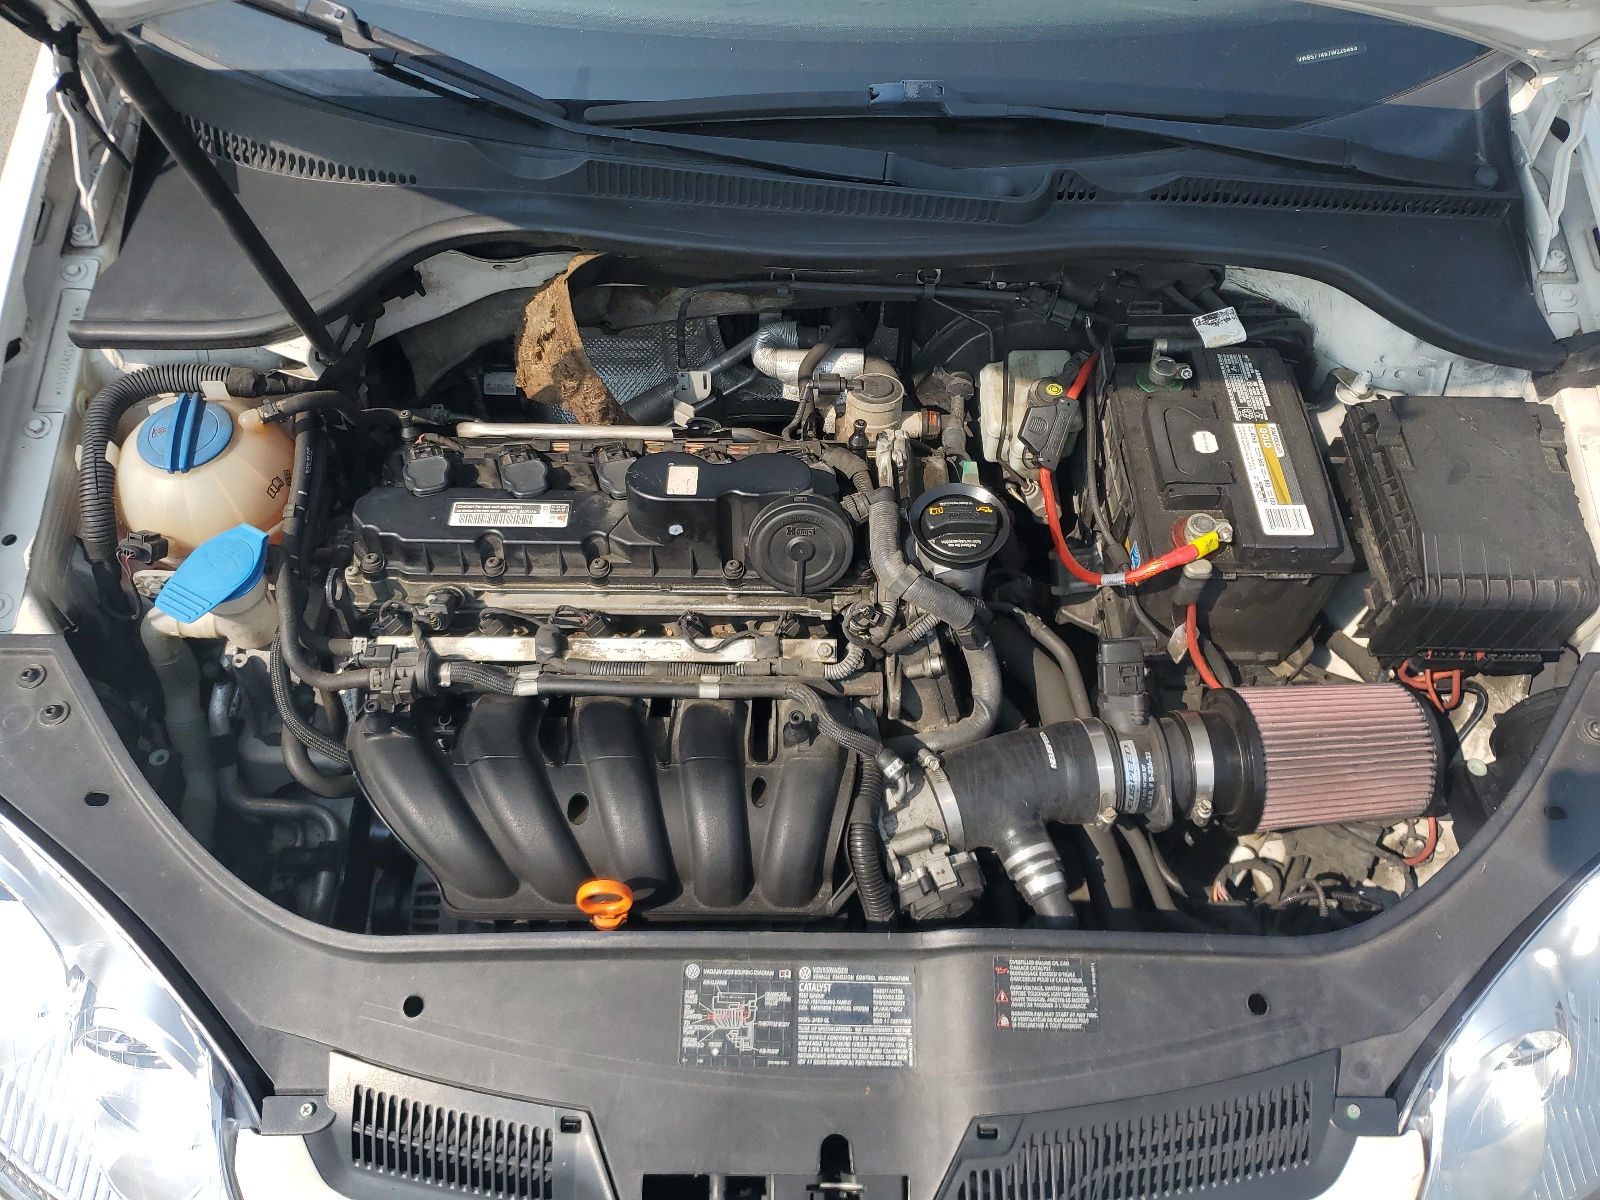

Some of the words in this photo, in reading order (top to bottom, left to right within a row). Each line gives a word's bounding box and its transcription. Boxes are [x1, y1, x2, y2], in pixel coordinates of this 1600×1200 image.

[1259, 427, 1272, 448] GOLD
[1039, 731, 1057, 769] NEUSPEED
[1123, 745, 1136, 811] NEUSPEED
[812, 966, 849, 974] VOLKSWAGEN
[799, 982, 832, 994] CATALYST
